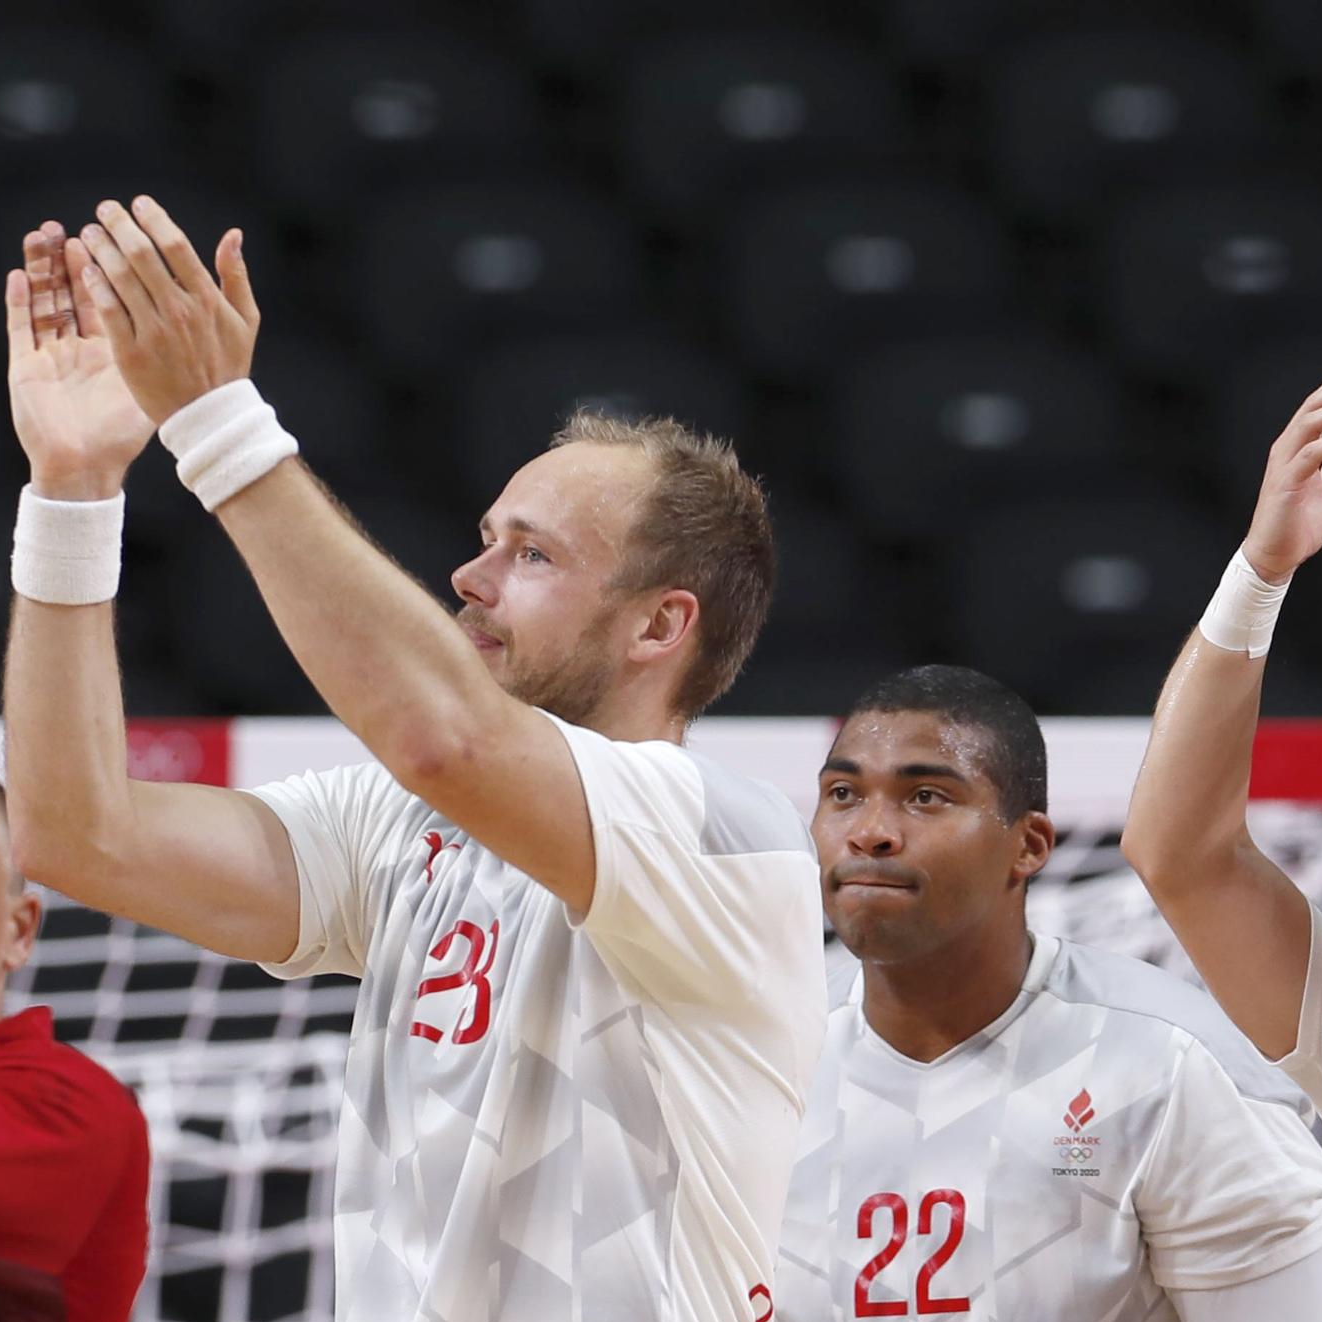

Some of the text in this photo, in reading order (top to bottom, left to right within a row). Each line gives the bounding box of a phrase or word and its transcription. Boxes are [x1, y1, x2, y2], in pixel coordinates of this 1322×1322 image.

[1053, 1136, 1101, 1146] DENMARK
[1052, 1167, 1100, 1177] TOKYO 2020
[853, 1188, 971, 1319] 22
